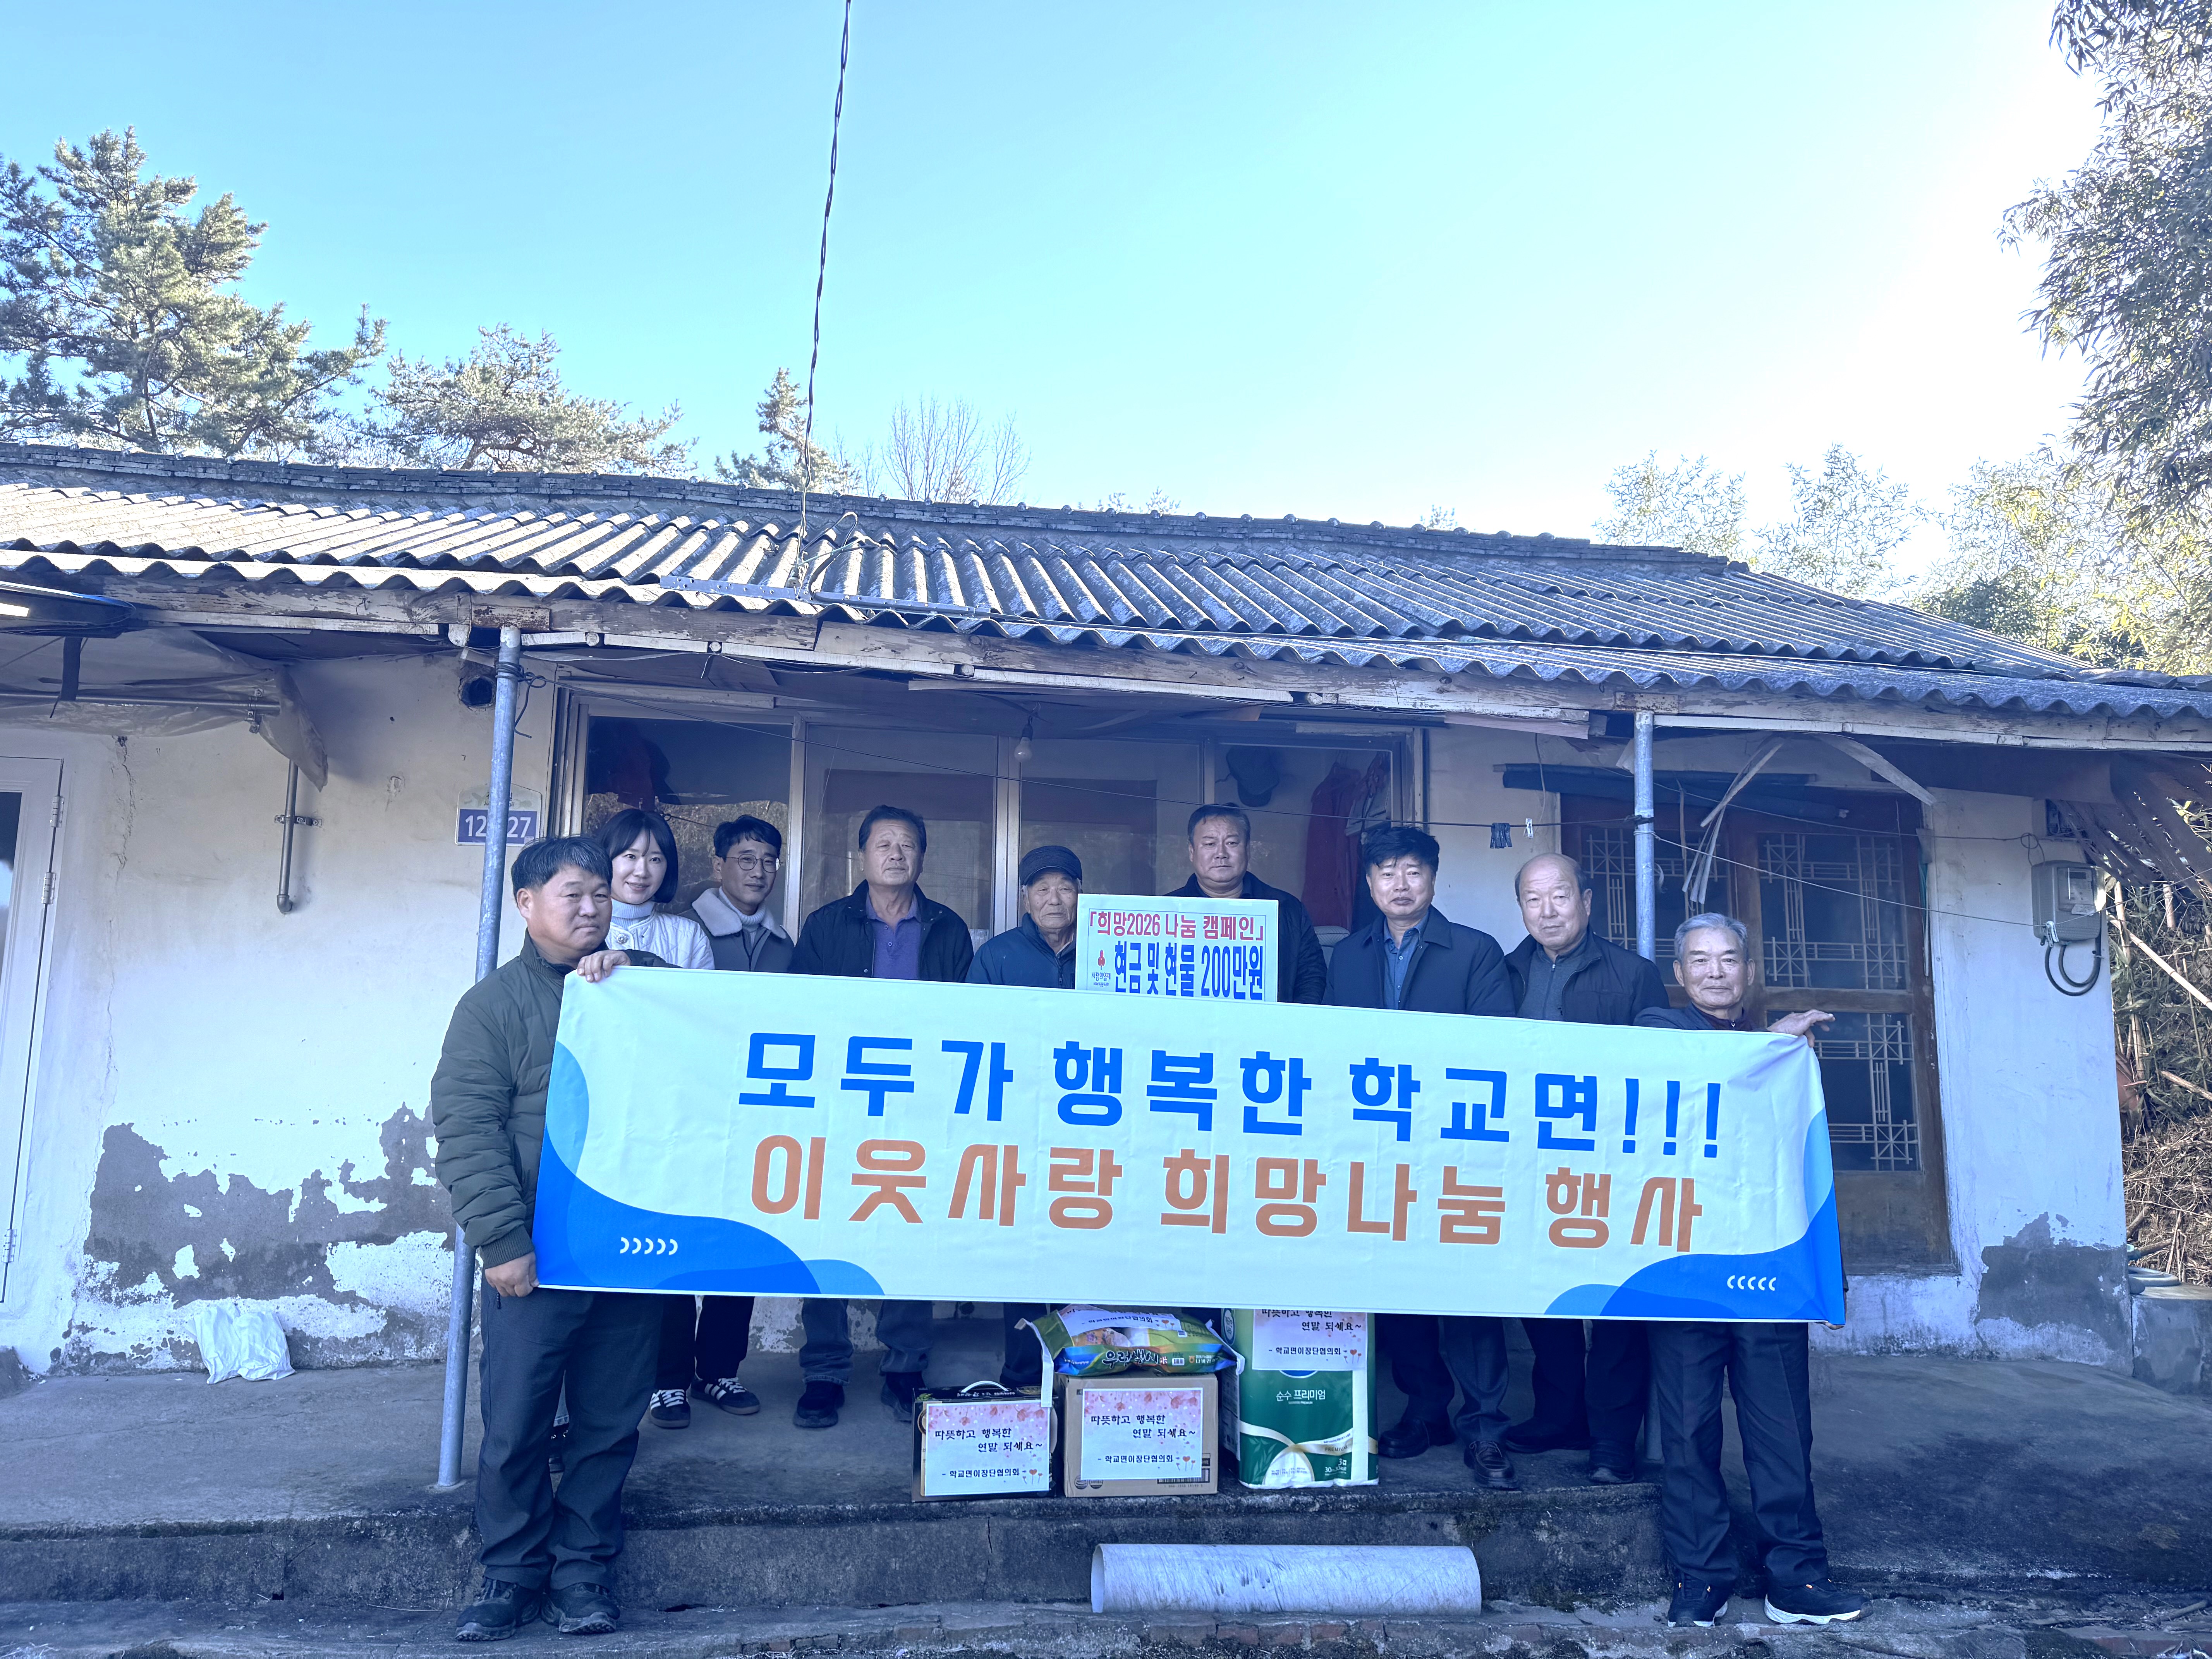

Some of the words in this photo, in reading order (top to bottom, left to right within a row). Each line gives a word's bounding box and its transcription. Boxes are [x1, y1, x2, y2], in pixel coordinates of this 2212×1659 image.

[1090, 911, 1159, 936] 「희망2026
[1165, 913, 1196, 939] 나눔
[1203, 915, 1263, 941] 캠페인」
[1114, 941, 1140, 994] 현금
[1147, 942, 1159, 994] 및
[1164, 942, 1195, 997] 현물
[1201, 945, 1263, 1000] 200만원
[739, 1032, 1014, 1121] 모두가
[1054, 1041, 1312, 1135] 행복한
[1350, 1058, 1721, 1158] 학교면!!!
[752, 1134, 1122, 1228] 이웃사랑
[1161, 1149, 1506, 1245] 희망나눔
[1546, 1167, 1702, 1252] 행사
[1302, 1322, 1320, 1331] 연말
[1325, 1322, 1361, 1331] 되세요~
[1276, 1347, 1341, 1355] 학교면이장단협의회
[1276, 1391, 1291, 1401] 순수
[1293, 1389, 1325, 1400] 프리미엄
[1091, 1415, 1130, 1425] 따뜻하고
[1136, 1415, 1165, 1424] 행복한
[935, 1429, 976, 1441] 따뜻하고
[981, 1428, 1012, 1438] 행복한
[1133, 1429, 1152, 1438] 연말
[1158, 1428, 1195, 1438] 되세요~
[978, 1442, 998, 1452] 연말
[1003, 1441, 1042, 1451] 되세요~
[950, 1468, 1019, 1478] 학교면이장단협의회
